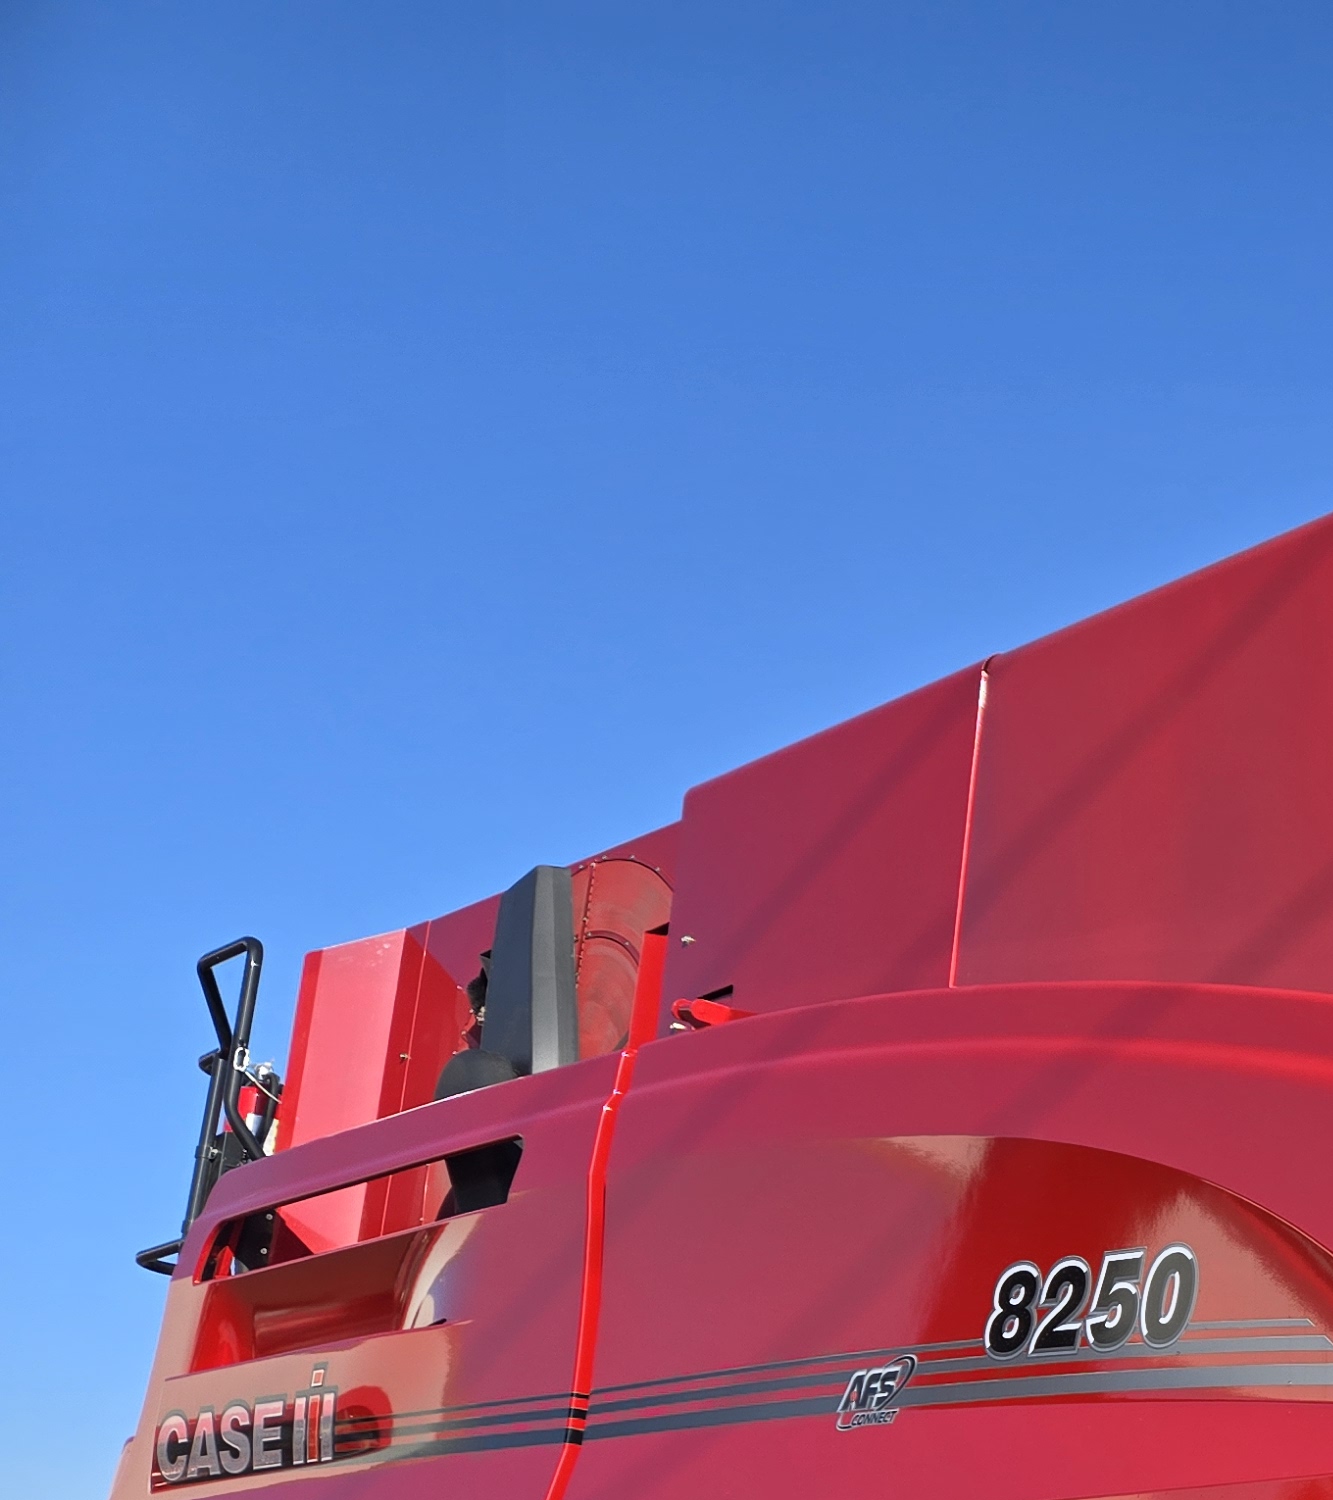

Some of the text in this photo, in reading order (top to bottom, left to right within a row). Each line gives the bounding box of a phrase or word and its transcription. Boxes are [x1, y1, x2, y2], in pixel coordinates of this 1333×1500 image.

[984, 1242, 1199, 1360] 8250
[836, 1365, 903, 1413] AFS
[851, 1408, 899, 1426] CONNECT
[156, 1401, 284, 1482] CASE
